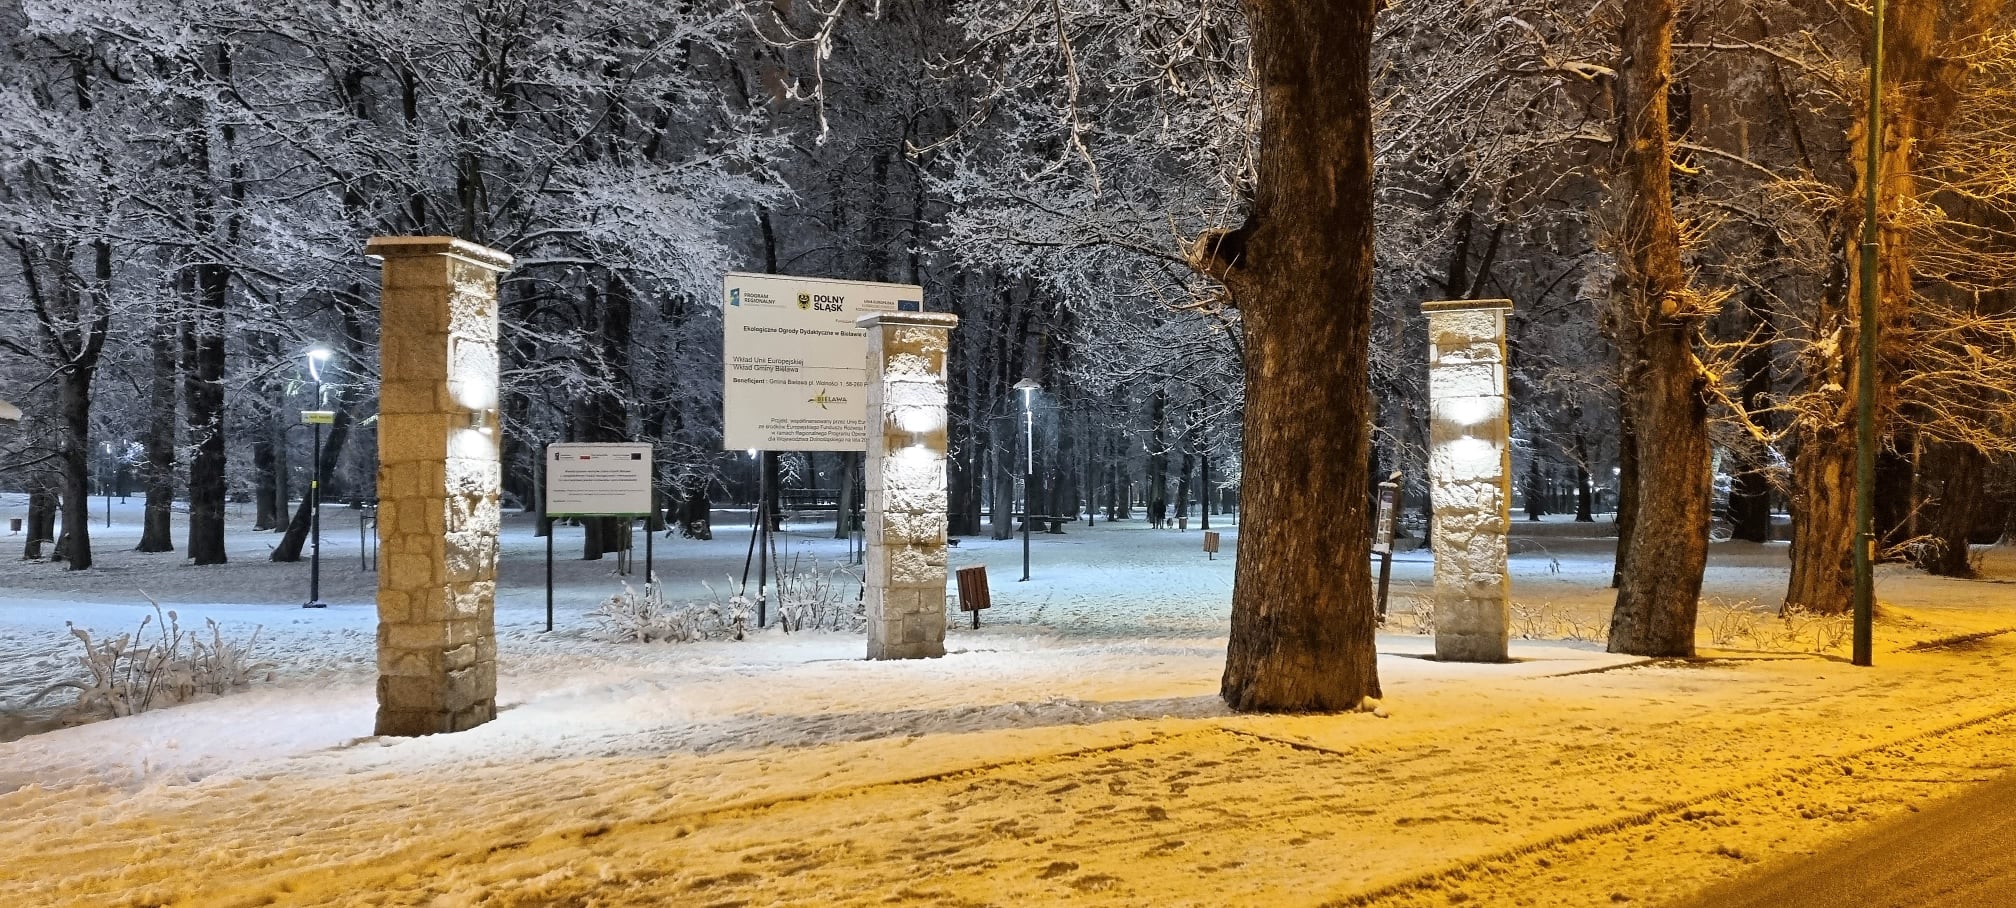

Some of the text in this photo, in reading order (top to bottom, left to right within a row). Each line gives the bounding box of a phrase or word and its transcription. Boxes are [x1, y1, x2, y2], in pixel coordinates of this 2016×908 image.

[813, 294, 844, 304] DOLNY
[813, 302, 842, 313] ŚLĄSK
[767, 357, 804, 367] Europejskiej
